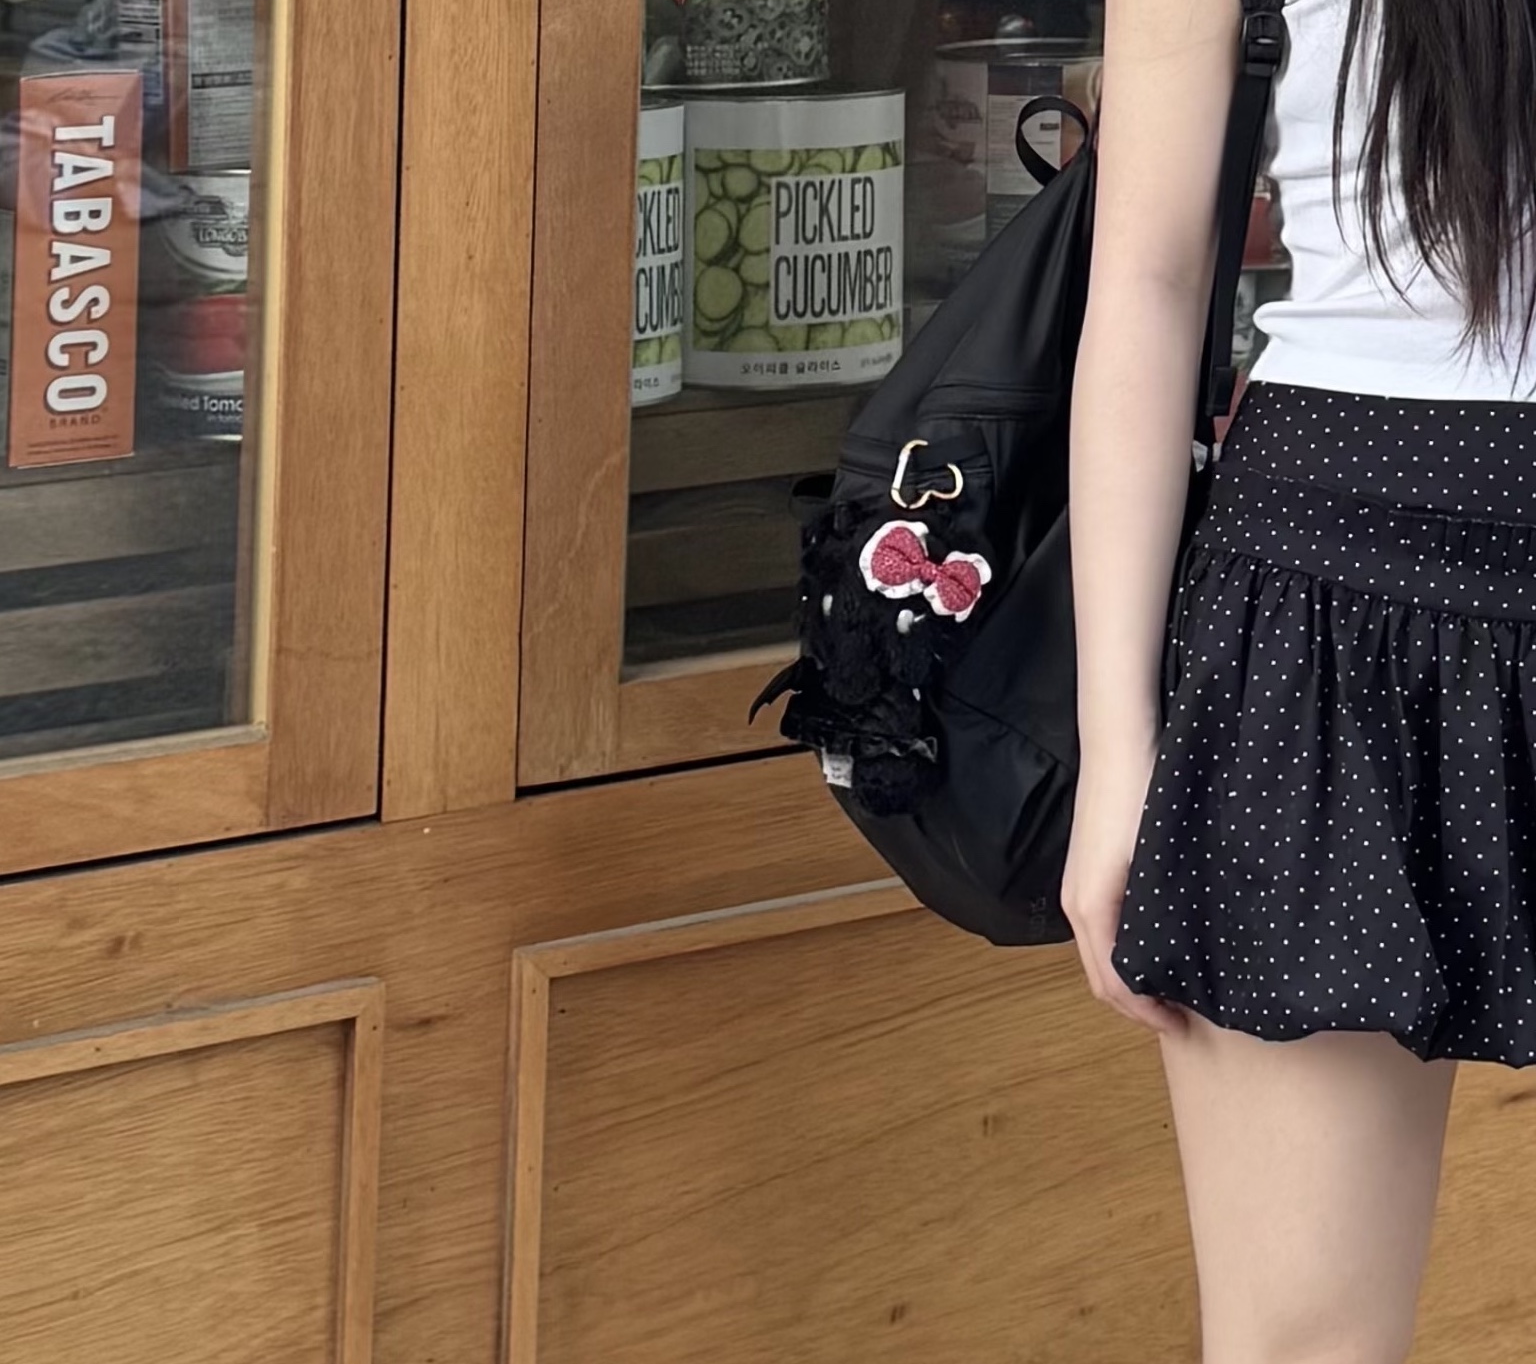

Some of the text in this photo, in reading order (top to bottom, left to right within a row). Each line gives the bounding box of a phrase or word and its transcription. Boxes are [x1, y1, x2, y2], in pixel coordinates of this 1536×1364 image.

[774, 176, 875, 246] PICKLED
[46, 114, 116, 414] TABASCO
[773, 246, 893, 321] CUCUMBER
